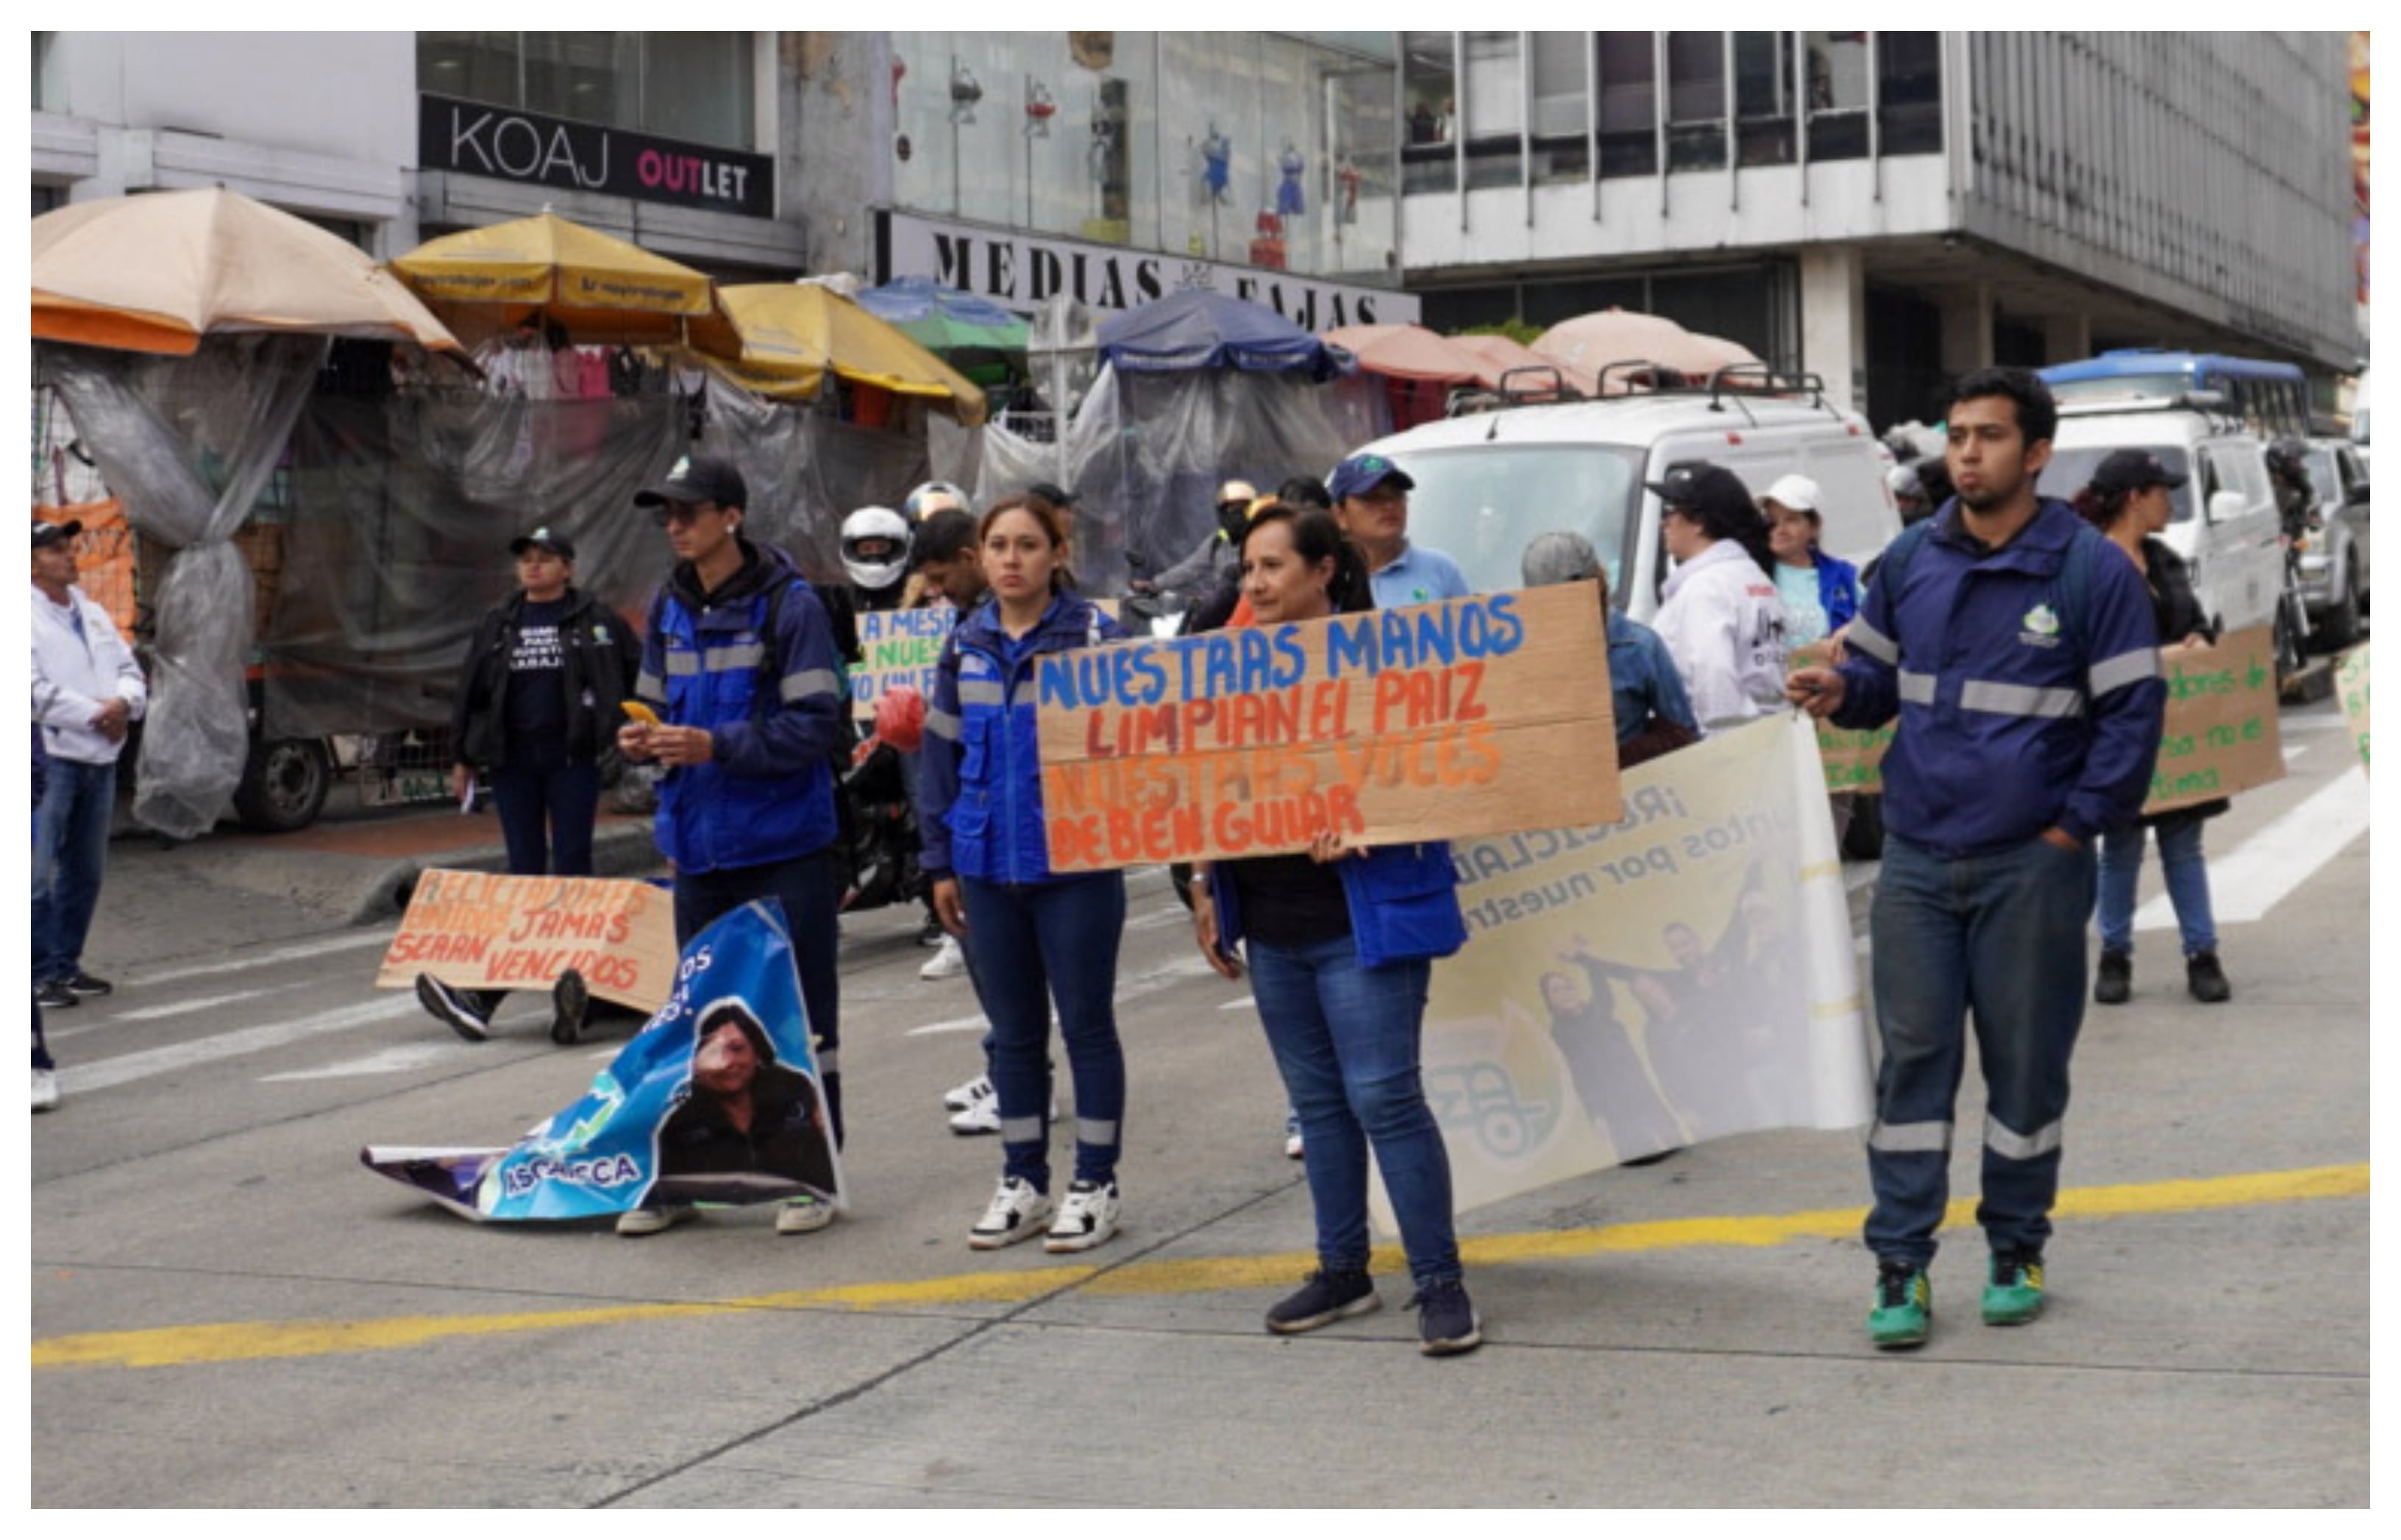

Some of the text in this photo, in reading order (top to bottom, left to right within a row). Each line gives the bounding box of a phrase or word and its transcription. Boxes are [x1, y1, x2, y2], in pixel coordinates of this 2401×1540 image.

[451, 106, 749, 202] KOAJ OUTLET
[933, 232, 1162, 309] MEDIAS
[1039, 593, 1523, 711] NUESTRAS MANOS
[1086, 661, 1487, 759] LIMPIAN EL PAIZ
[1047, 722, 1502, 813] NUESTRAS VOCES
[1214, 783, 1365, 853] GUIAR
[388, 932, 492, 964] SERAN
[508, 909, 631, 945] JAMAS
